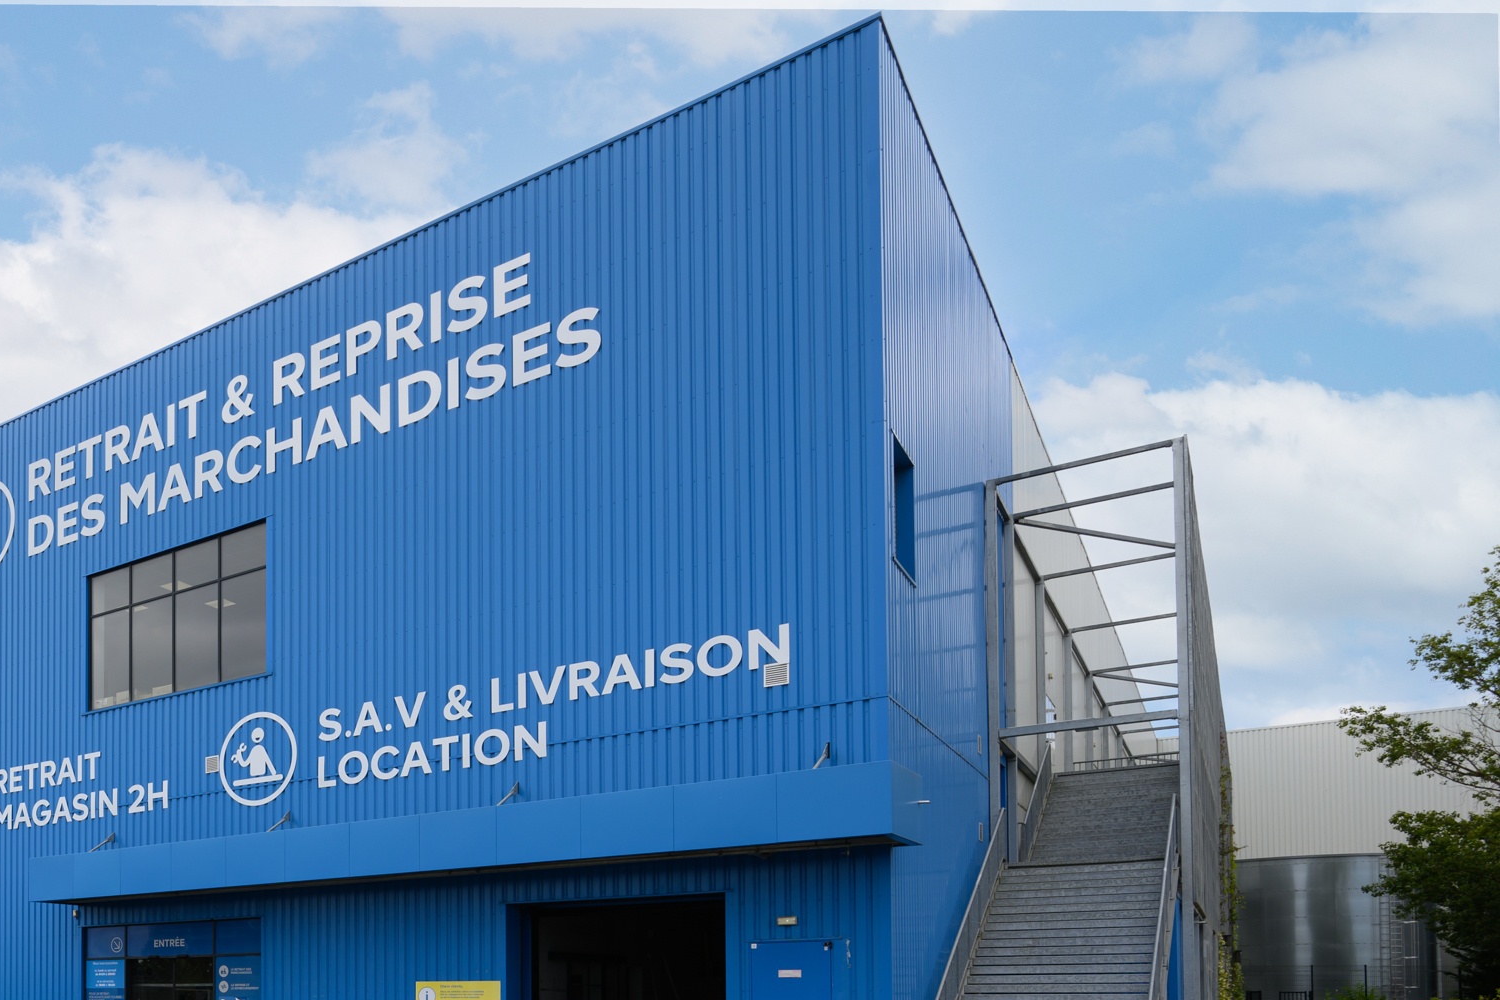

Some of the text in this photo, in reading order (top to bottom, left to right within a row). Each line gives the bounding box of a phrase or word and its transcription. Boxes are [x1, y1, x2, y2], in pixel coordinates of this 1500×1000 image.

[27, 252, 532, 502] RETRAIT & REPRISE
[27, 307, 602, 557] DES MARCHANDISES
[318, 623, 790, 742] S.A.V & LIVRAISON
[128, 779, 169, 814] 2H
[317, 721, 548, 789] LOCATION
[153, 936, 185, 948] ENTRÉE
